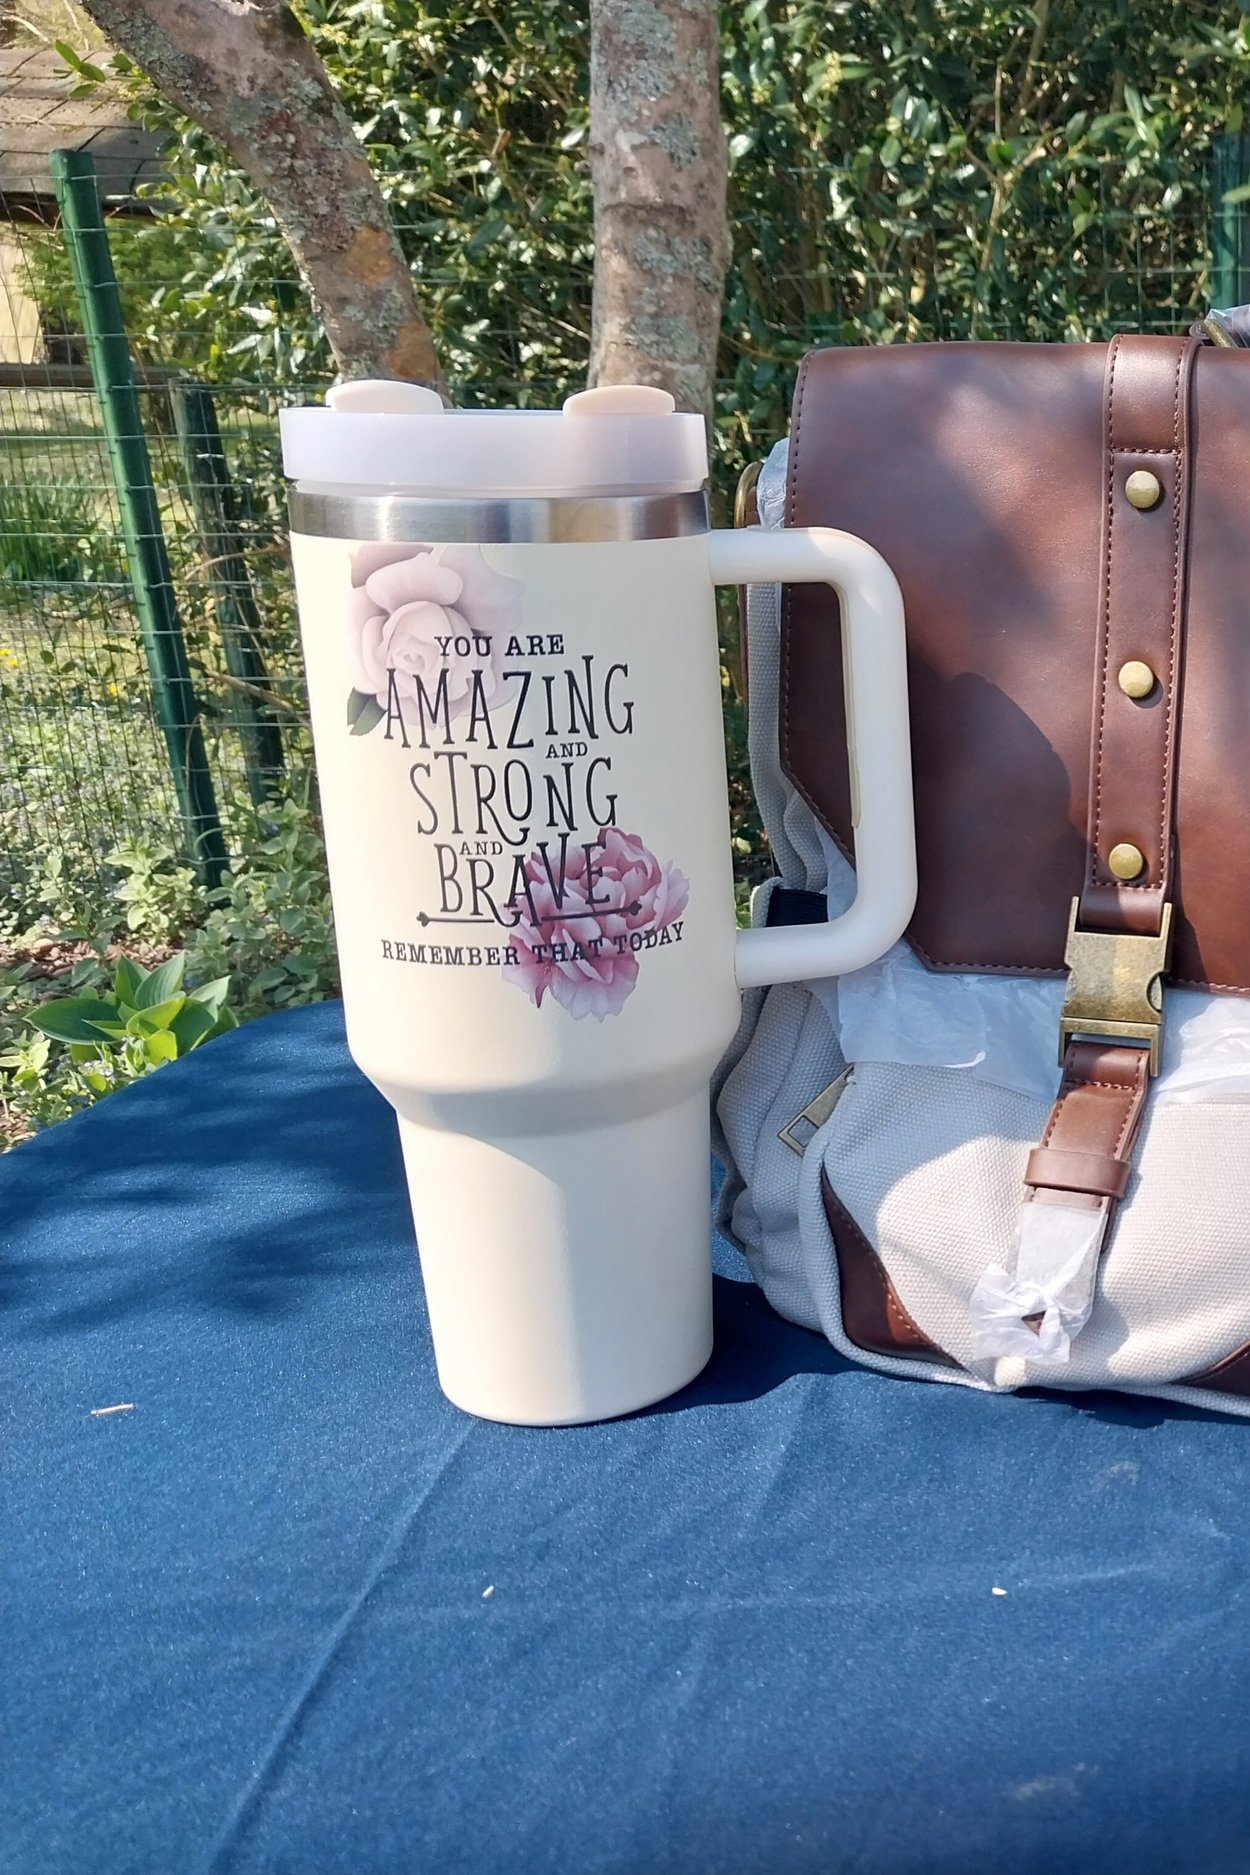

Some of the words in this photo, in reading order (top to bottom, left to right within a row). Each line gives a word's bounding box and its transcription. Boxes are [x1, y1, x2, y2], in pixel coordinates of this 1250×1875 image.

[434, 635, 493, 657] YOU
[504, 633, 565, 656] ARE
[383, 655, 634, 749] AMAZING
[545, 742, 589, 759] AND
[409, 751, 618, 846] STRONG
[459, 841, 504, 856] AND
[434, 832, 611, 928] BRAVE
[381, 939, 521, 966] REMEMBER
[532, 936, 605, 963] THAT
[614, 922, 685, 955] TODAY
